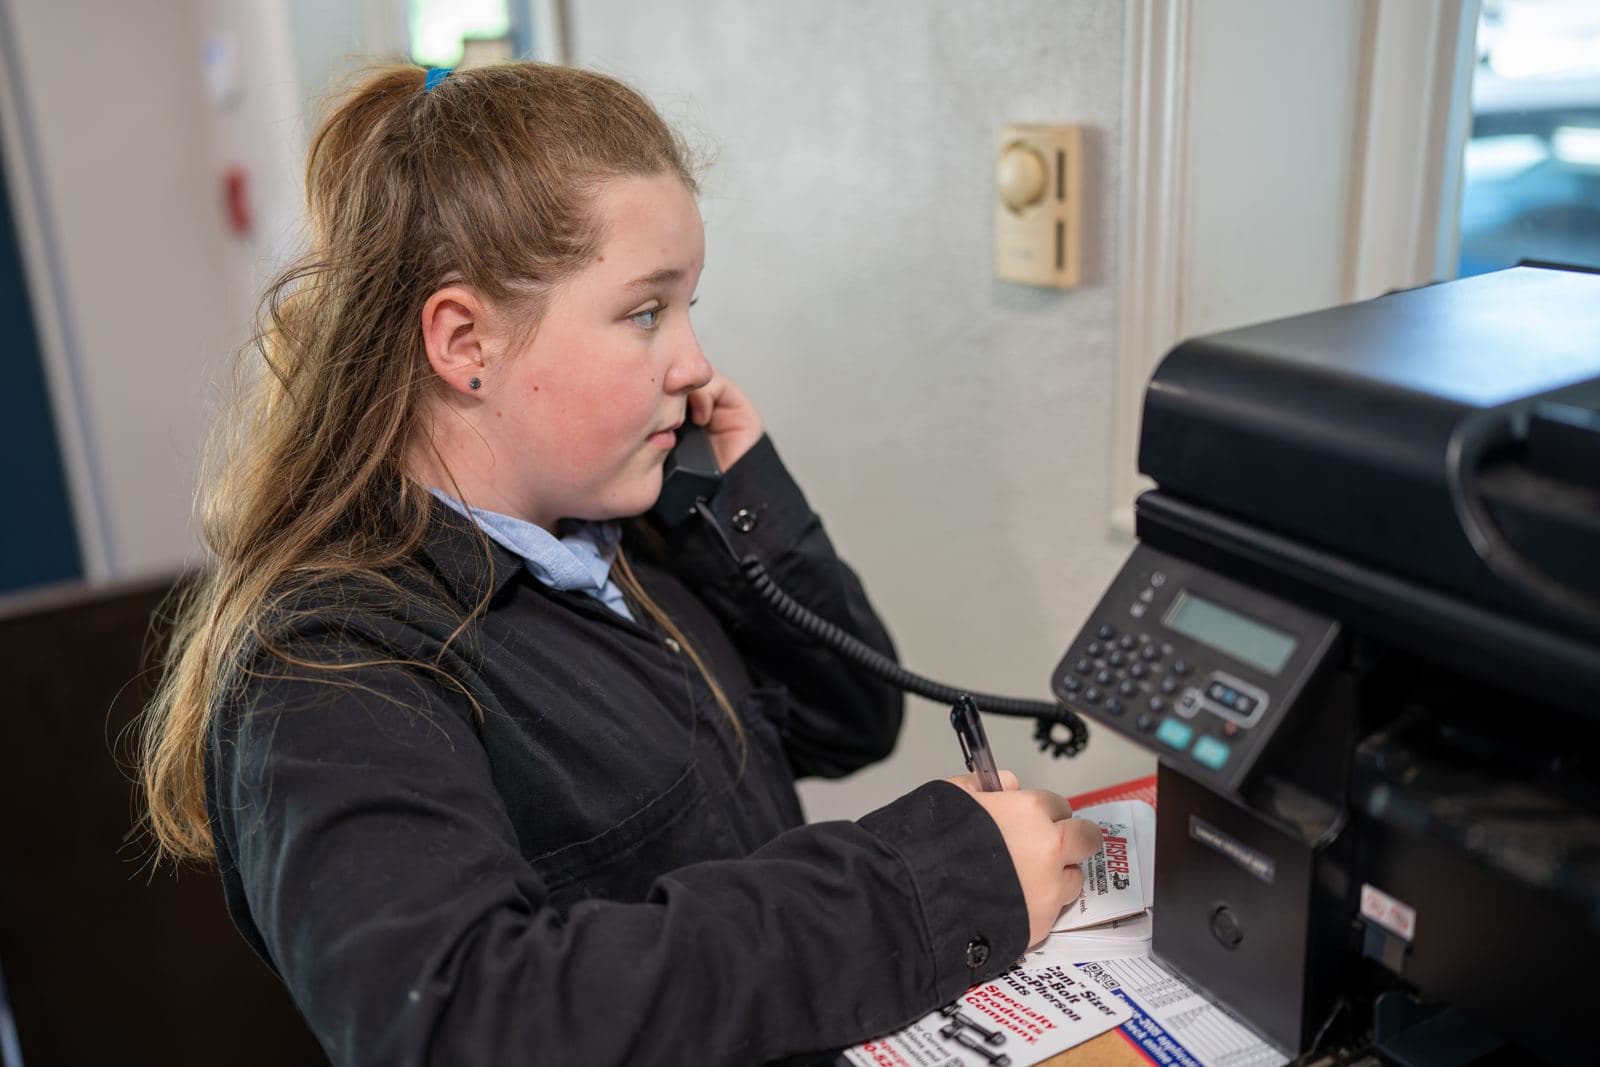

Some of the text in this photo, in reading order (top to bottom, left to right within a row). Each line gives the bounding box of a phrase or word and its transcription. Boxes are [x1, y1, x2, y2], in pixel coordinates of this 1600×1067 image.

[1102, 828, 1130, 874] JASPER
[1001, 974, 1031, 997] truts
[1036, 971, 1081, 1004] 2-Bolt
[1080, 989, 1118, 1017] Sizer
[973, 990, 1045, 1036] Products
[984, 984, 1058, 1030] Specialty
